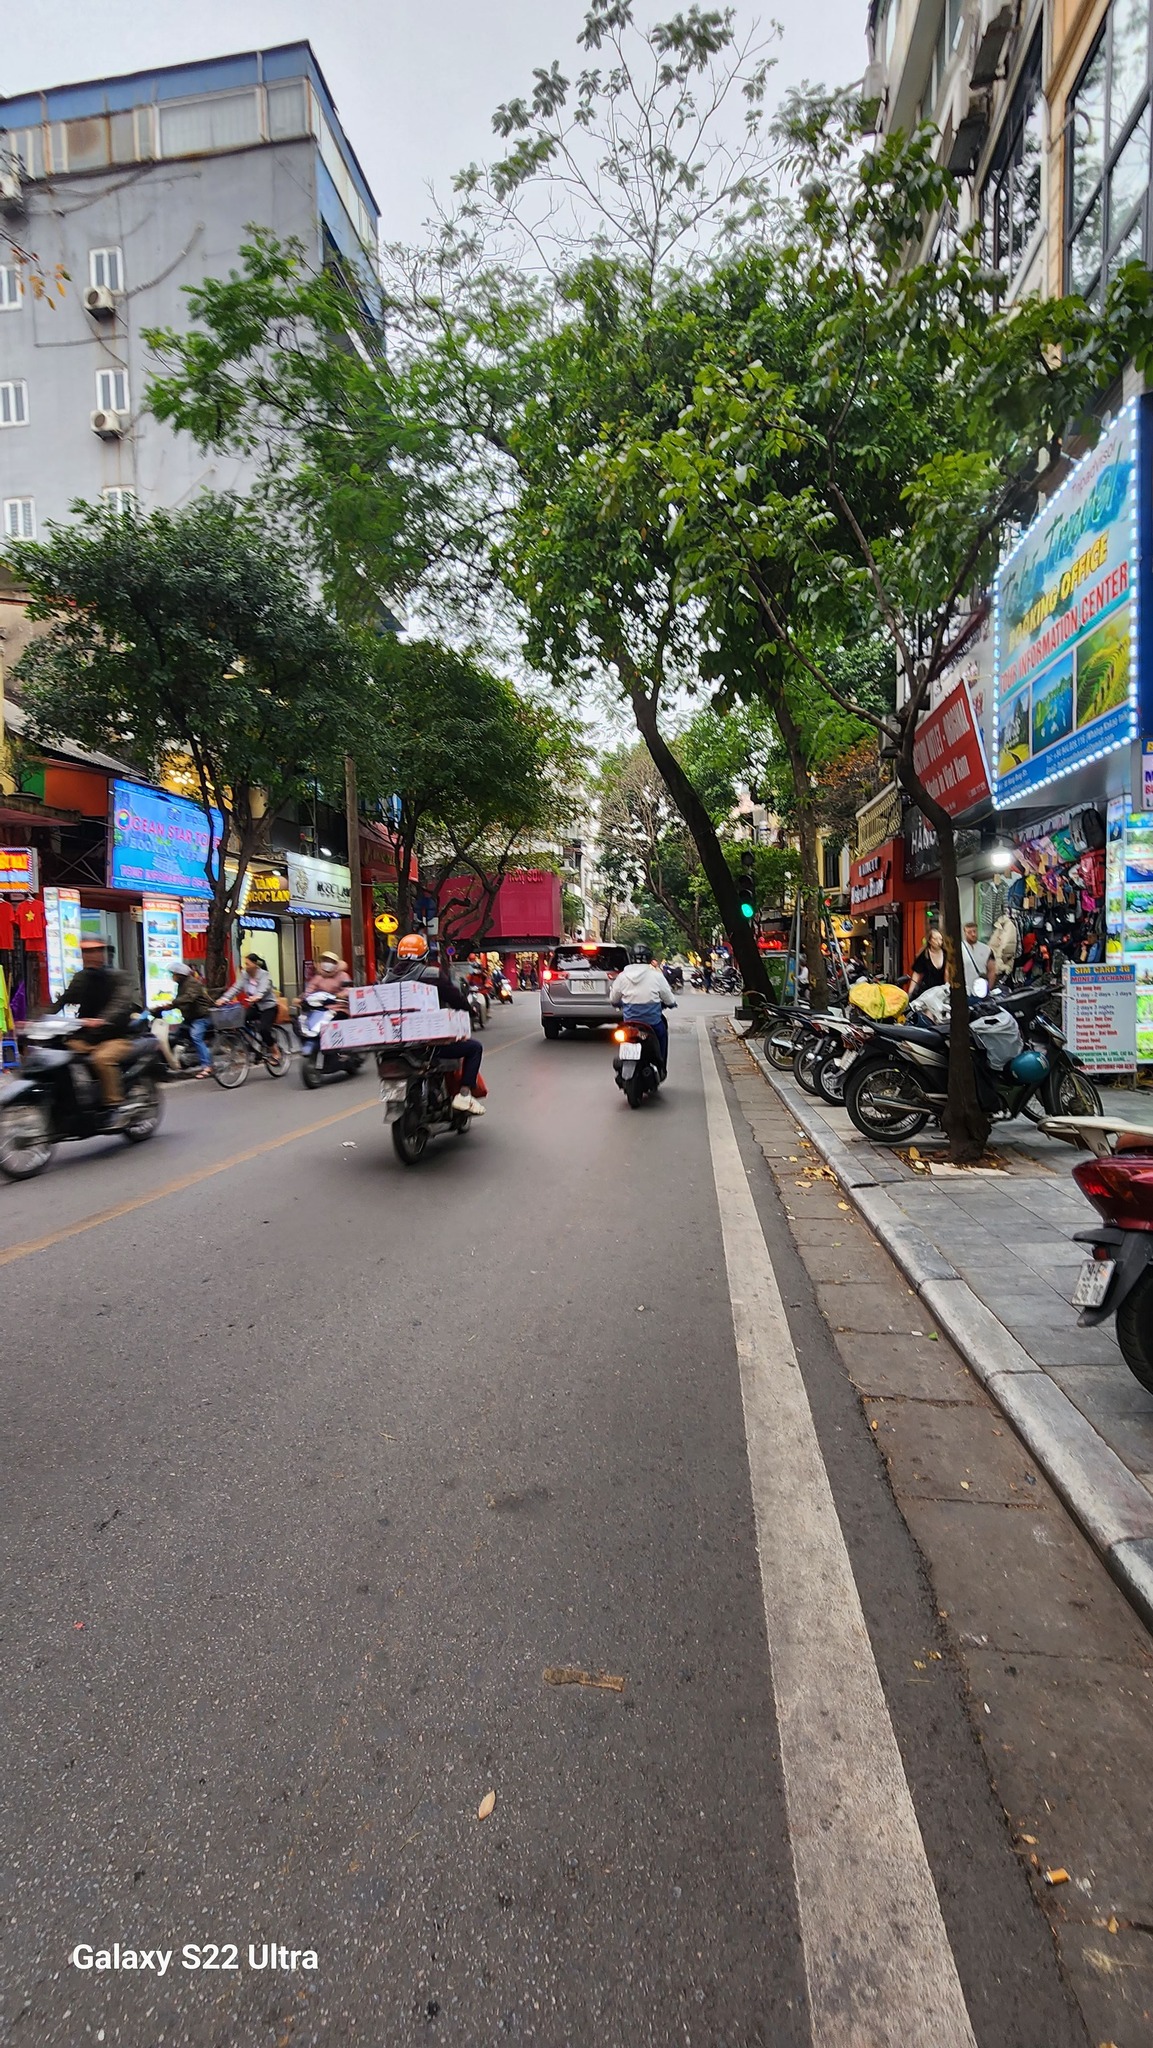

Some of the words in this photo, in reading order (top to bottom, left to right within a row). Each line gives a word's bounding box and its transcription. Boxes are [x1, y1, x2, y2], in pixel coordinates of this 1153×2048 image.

[1008, 585, 1058, 653] BOOKING
[1060, 531, 1110, 601] OFFICE
[1018, 609, 1078, 678] INFORMATION
[1080, 561, 1129, 625] CENTER
[116, 809, 165, 836] OCEAN
[167, 825, 192, 844] STAR
[1074, 966, 1091, 975] SIM
[1093, 966, 1117, 974] CARD
[1119, 965, 1130, 973] 4G
[1097, 974, 1134, 982] EXCHANGE
